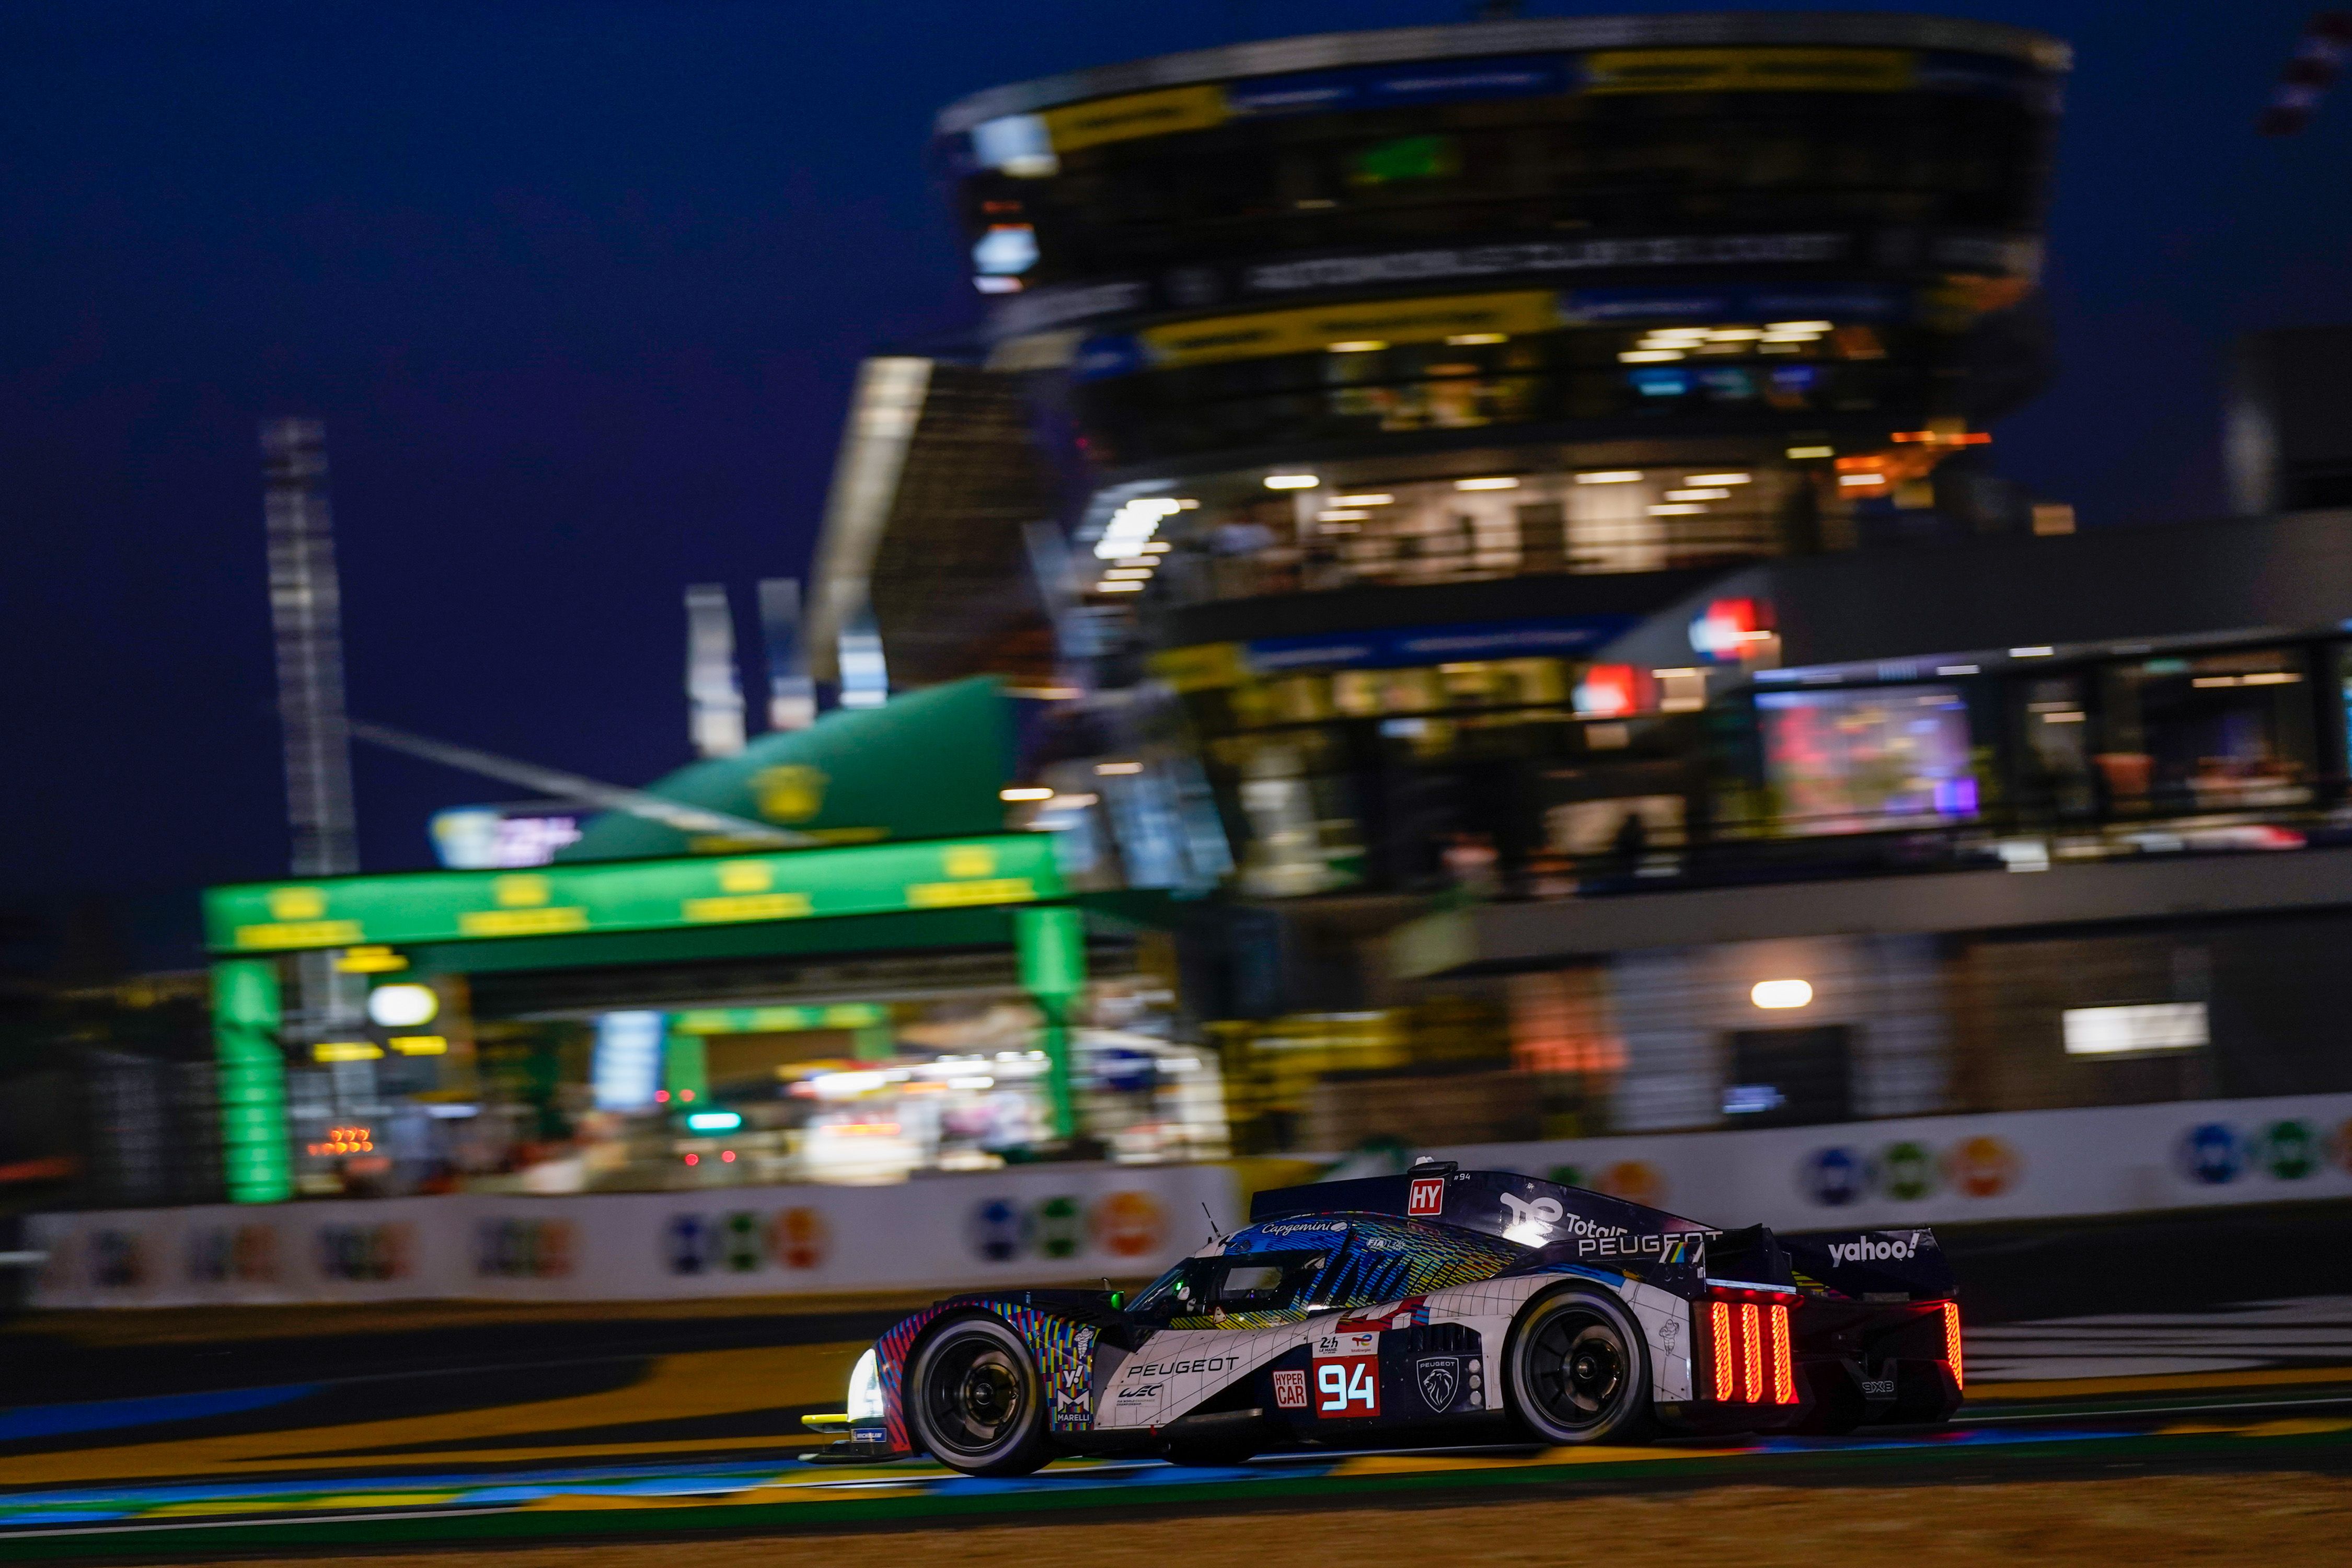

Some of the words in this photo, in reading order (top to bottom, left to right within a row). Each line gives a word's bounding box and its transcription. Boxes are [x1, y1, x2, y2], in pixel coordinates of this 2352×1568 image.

[1412, 1185, 1441, 1209] HY
[1262, 1221, 1331, 1236] Capgemini
[1828, 1232, 1920, 1267] yahoo!
[1127, 1357, 1239, 1378] PEUGEOT
[1275, 1373, 1303, 1385] HYPER
[1318, 1363, 1375, 1411] 94
[1862, 1380, 1894, 1393] 9X8
[1118, 1385, 1162, 1398] WEC
[1277, 1386, 1305, 1404] CAR
